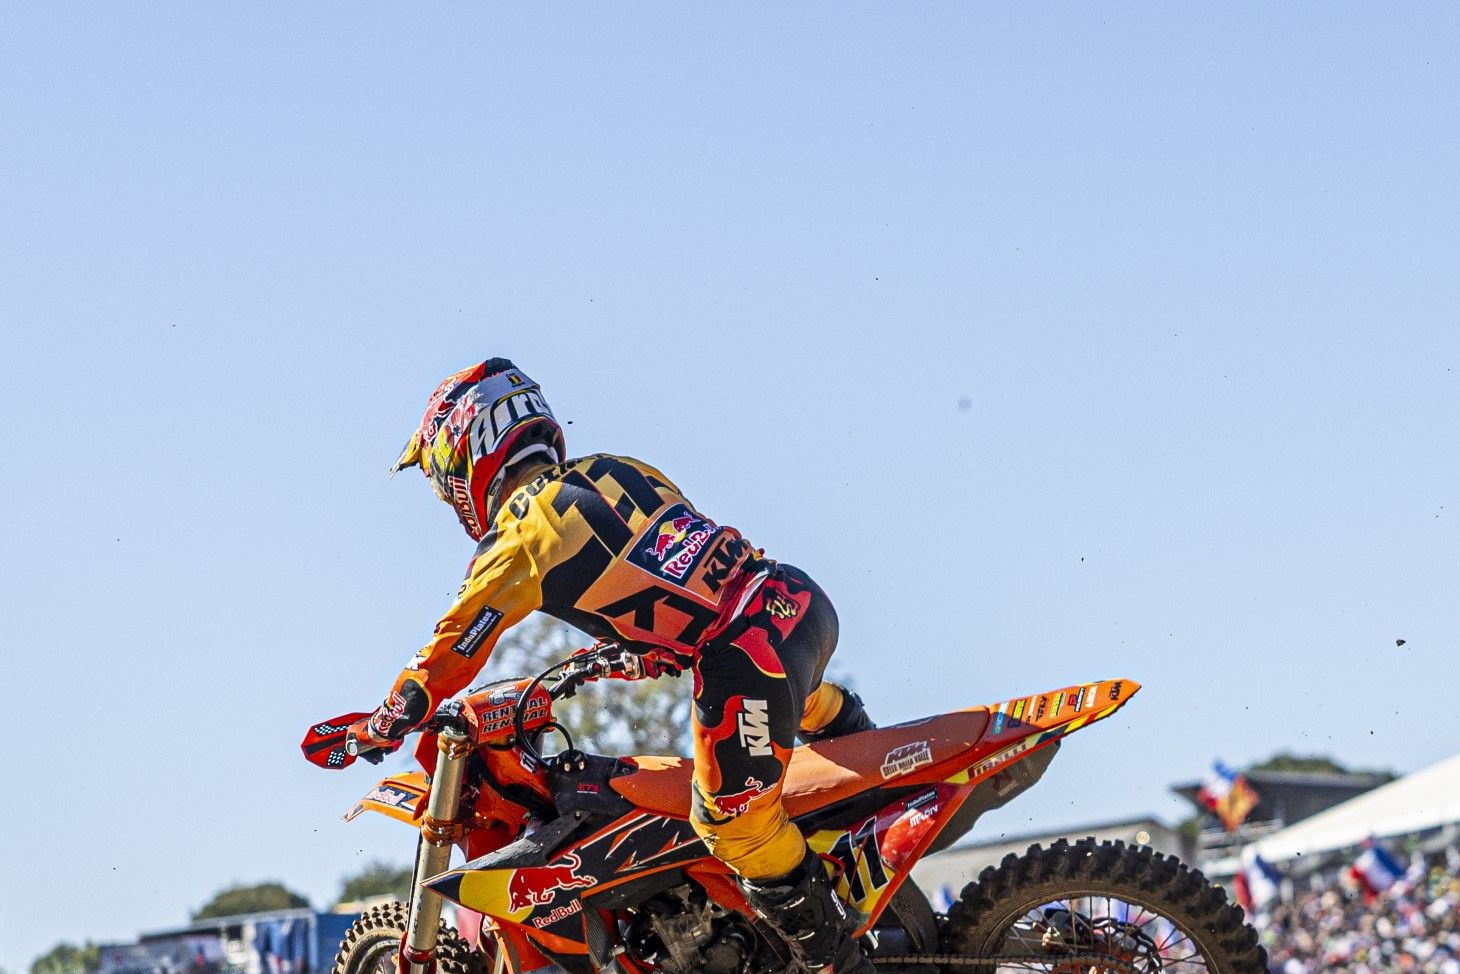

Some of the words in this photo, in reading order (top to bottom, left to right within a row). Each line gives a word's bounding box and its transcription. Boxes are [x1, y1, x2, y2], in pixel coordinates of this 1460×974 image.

[702, 536, 751, 595] KTM
[457, 611, 493, 651] InduPlates
[482, 696, 548, 723] RENTAL
[737, 698, 774, 757] KTM
[827, 816, 890, 905] 11
